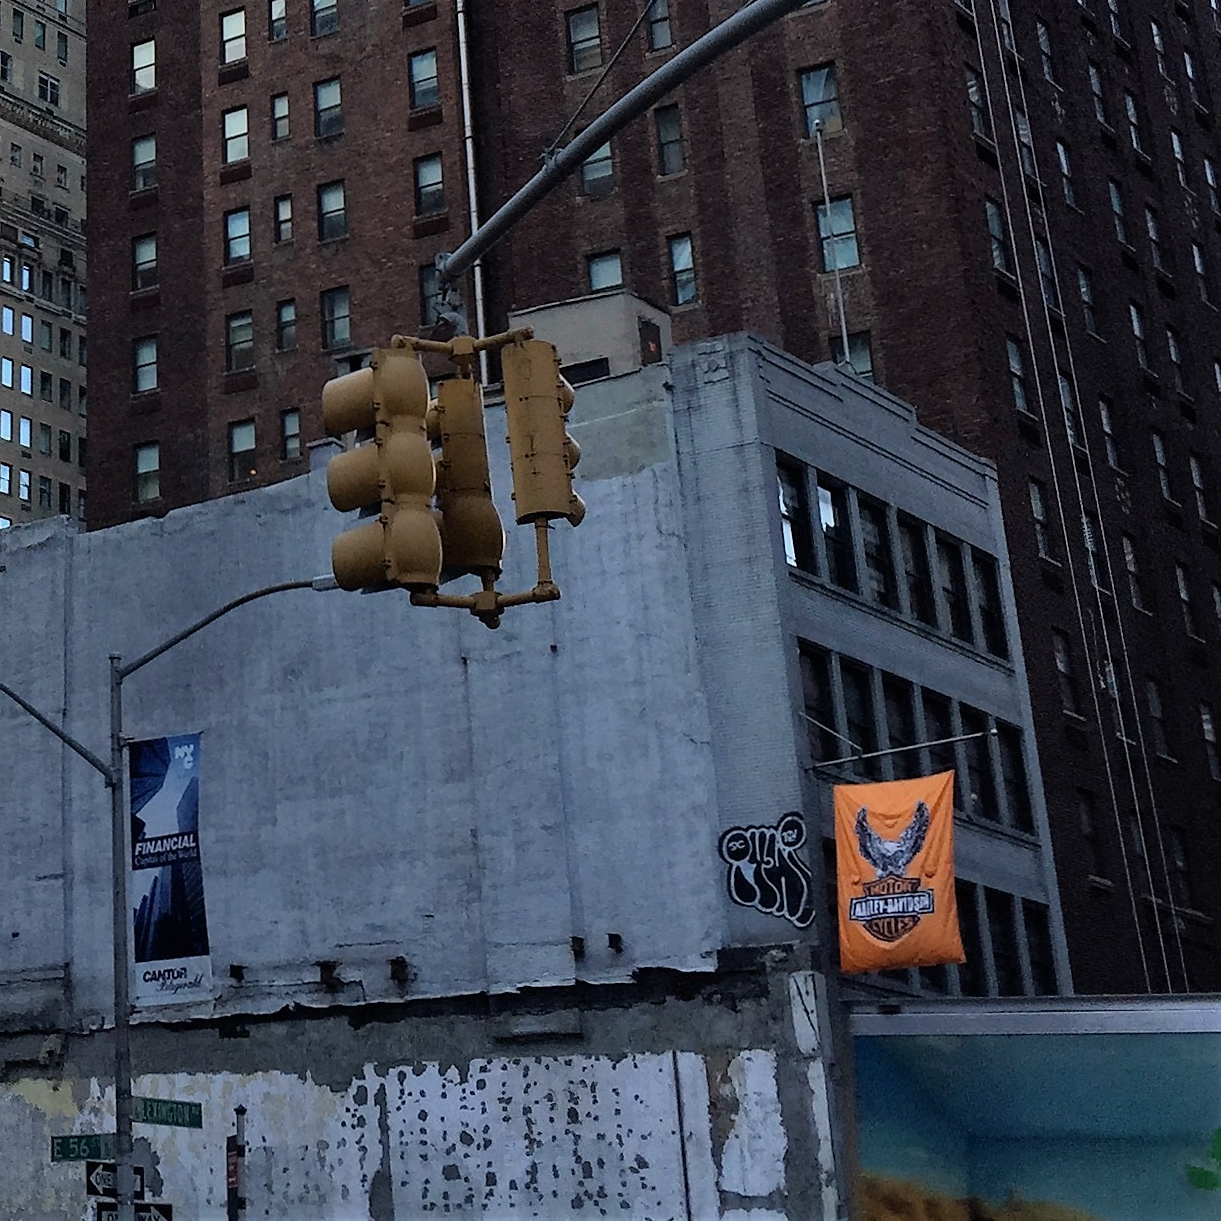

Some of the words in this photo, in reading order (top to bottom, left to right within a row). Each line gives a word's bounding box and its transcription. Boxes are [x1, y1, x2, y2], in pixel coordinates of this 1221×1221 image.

[135, 834, 196, 855] FINANCIAL
[870, 879, 912, 895] MOTOR
[872, 917, 914, 937] CYCLES
[143, 967, 187, 982] CANTOR
[53, 1139, 63, 1158] E
[69, 1138, 90, 1158] 56
[95, 1171, 112, 1188] ONE
